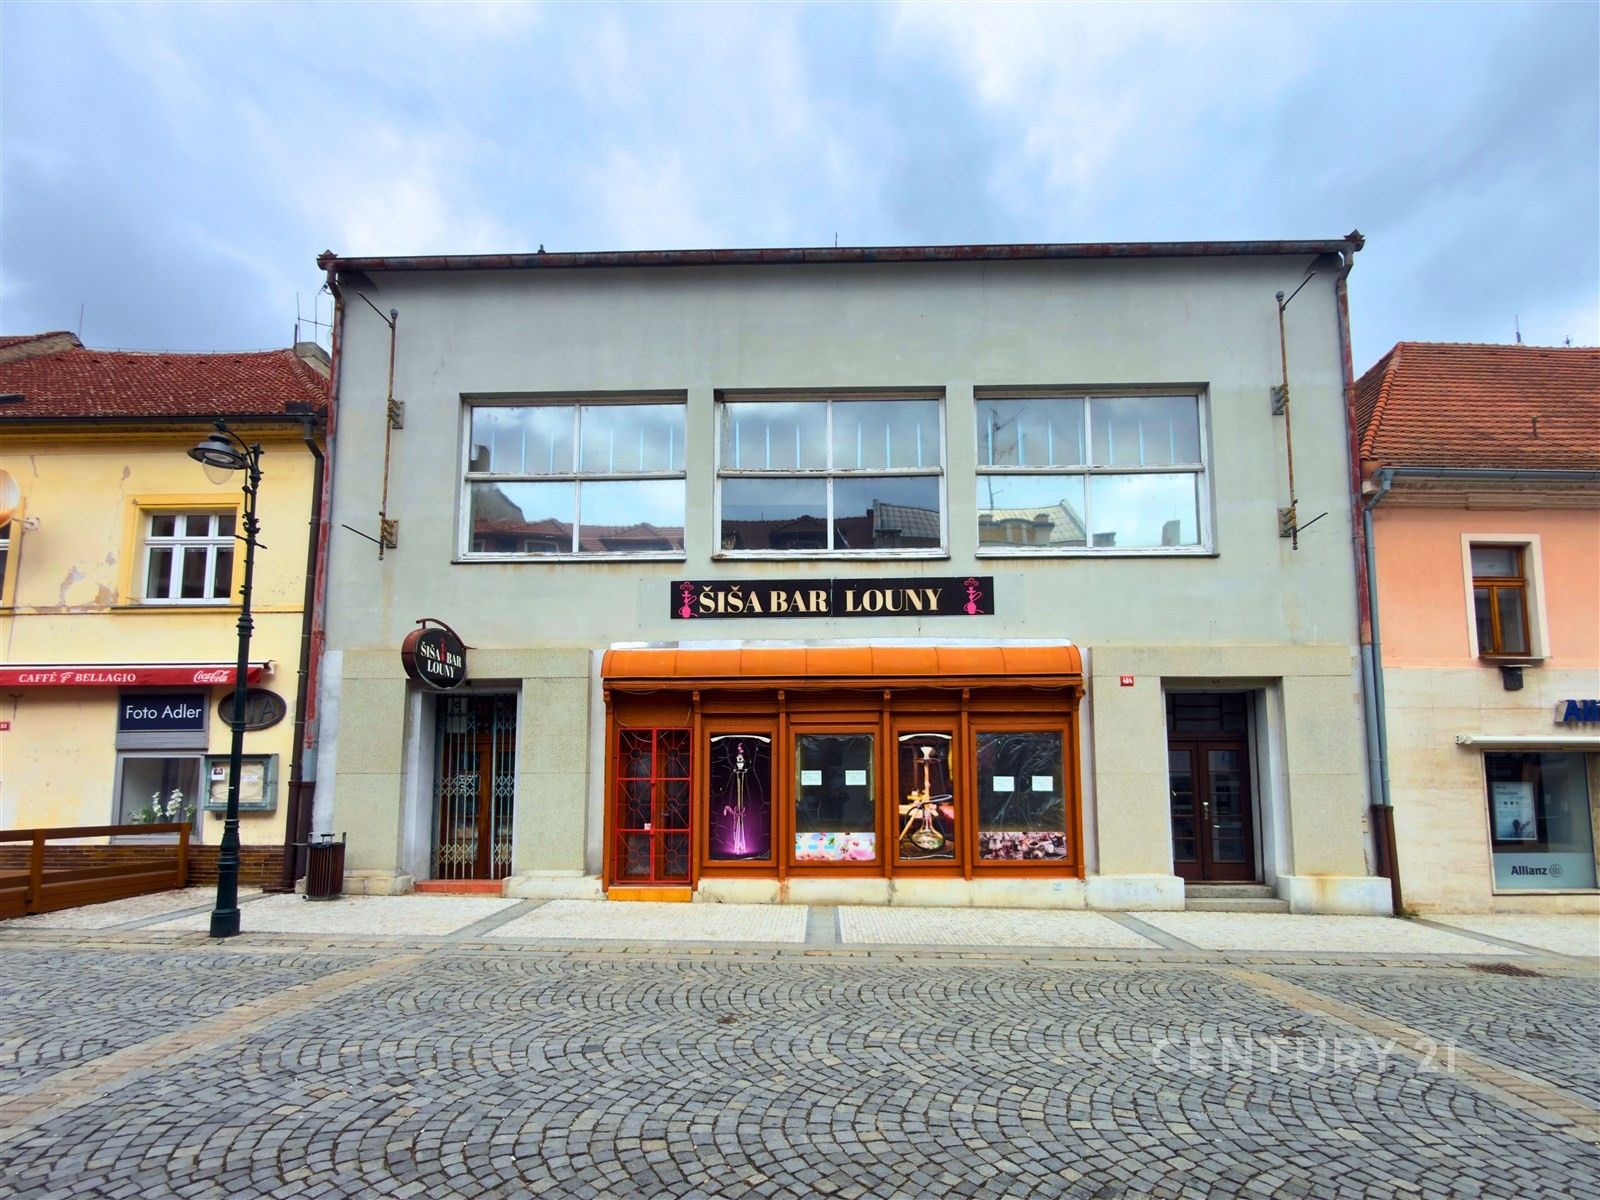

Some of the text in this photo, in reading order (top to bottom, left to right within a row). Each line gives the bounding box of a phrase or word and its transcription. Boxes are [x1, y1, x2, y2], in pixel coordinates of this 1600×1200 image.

[699, 585, 942, 613] ŠIŠA BAR LOUNY
[420, 641, 462, 667] ŠIŠA BAR
[19, 671, 57, 683] CAFFÉ
[74, 672, 137, 683] BELLAGIO
[427, 660, 455, 678] LOUNY
[126, 703, 202, 719] Foto Adler
[1511, 865, 1548, 876] Allianz
